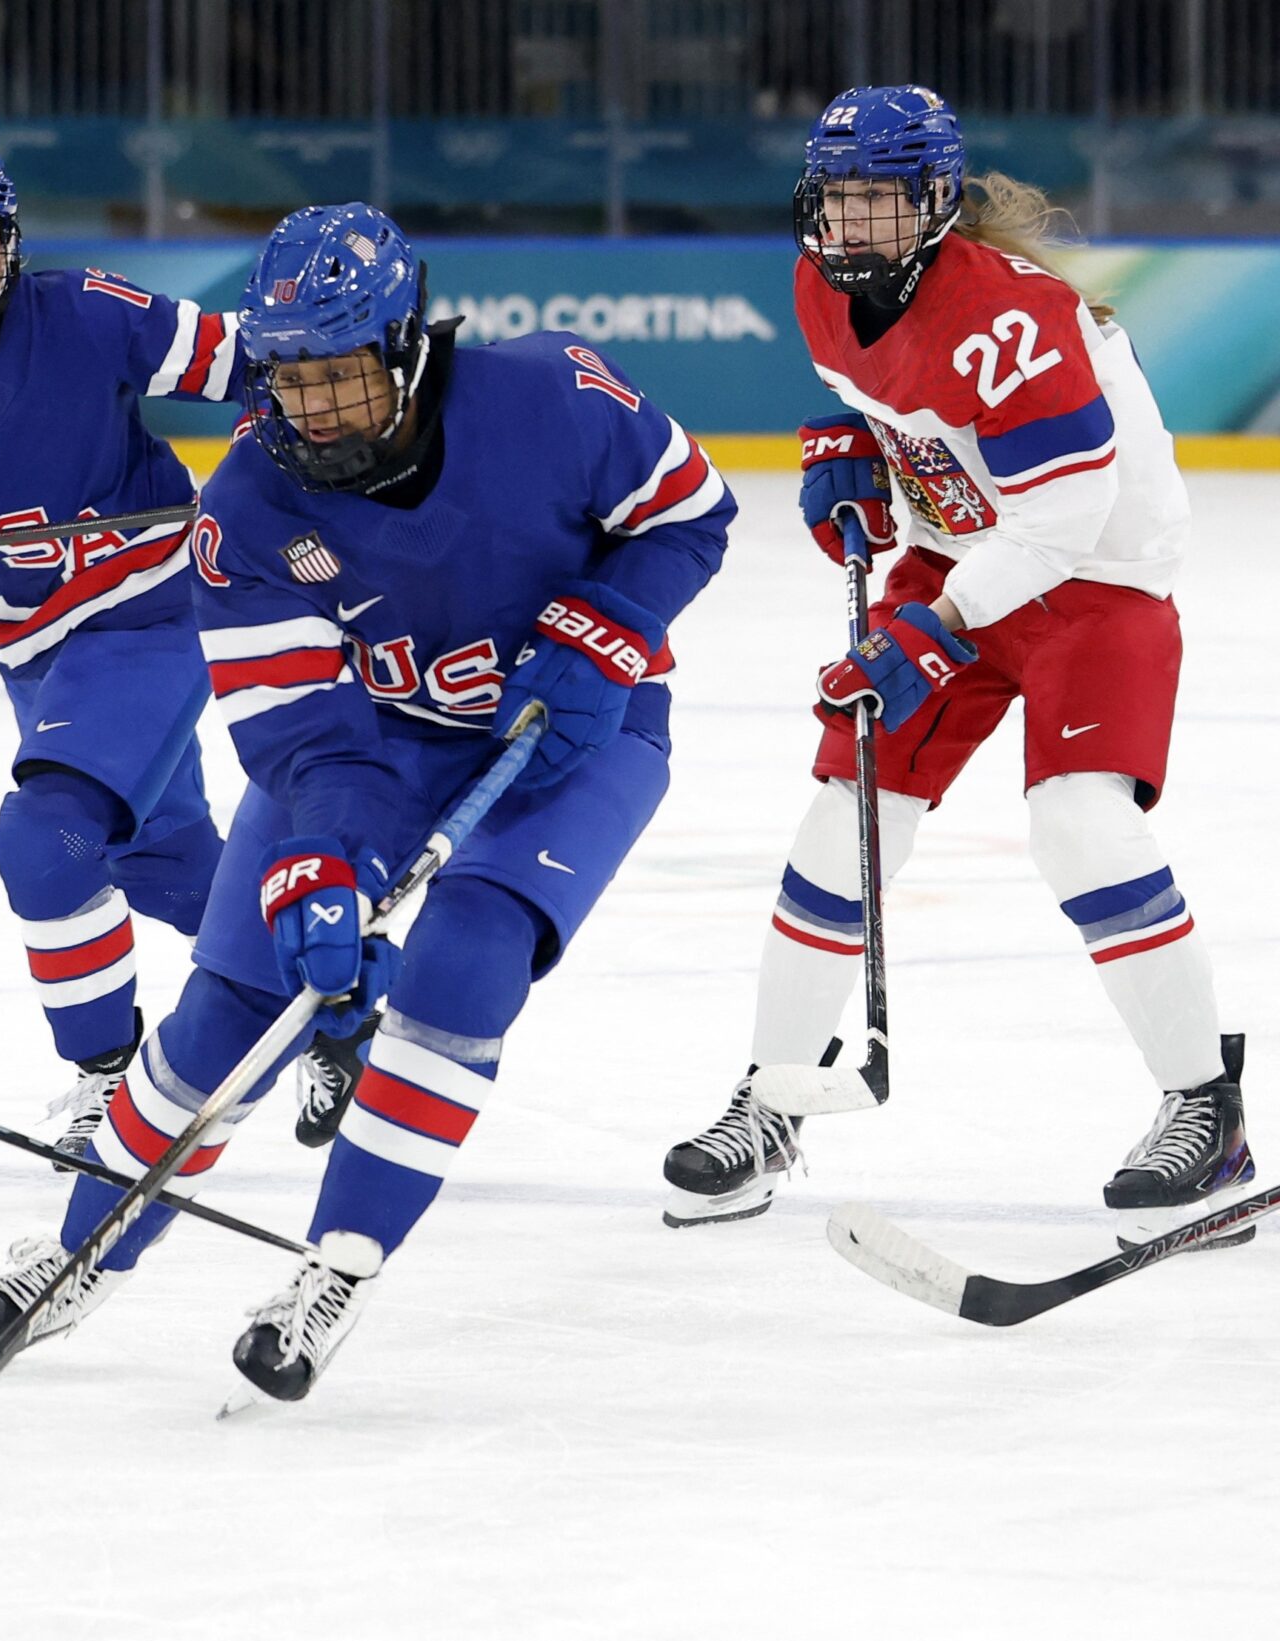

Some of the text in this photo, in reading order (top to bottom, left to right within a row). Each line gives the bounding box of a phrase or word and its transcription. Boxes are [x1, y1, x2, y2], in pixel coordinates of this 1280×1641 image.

[825, 106, 859, 126] 22
[82, 267, 153, 310] 1
[273, 279, 298, 305] 10
[898, 261, 924, 304] CCM
[427, 294, 777, 342] ANO CORTINA
[952, 308, 1064, 410] 22
[801, 434, 855, 462] CM
[288, 537, 318, 562] USA
[536, 601, 648, 685] BAUER
[343, 634, 506, 714] US
